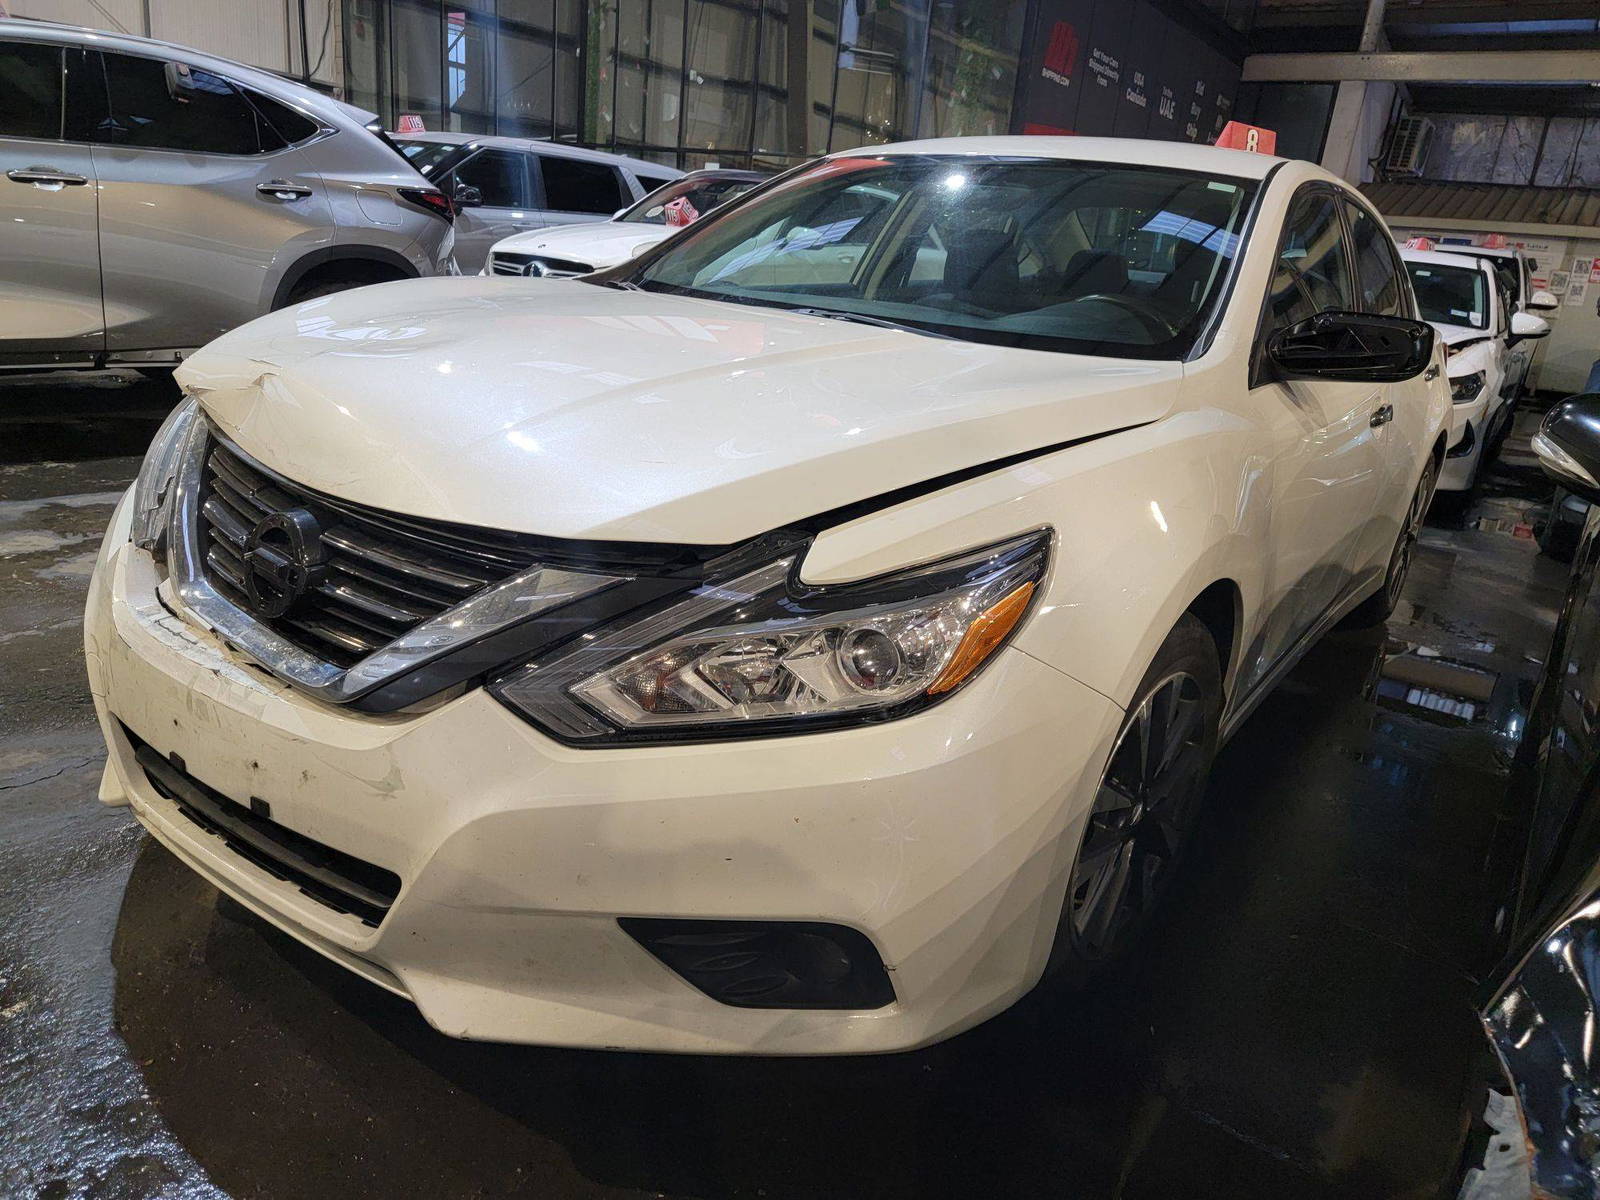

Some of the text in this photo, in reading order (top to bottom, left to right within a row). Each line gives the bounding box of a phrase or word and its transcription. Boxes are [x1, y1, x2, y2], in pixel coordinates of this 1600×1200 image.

[1134, 71, 1145, 88] USA
[1126, 88, 1147, 107] Canada
[1160, 96, 1175, 120] UAE
[1246, 130, 1259, 152] 8
